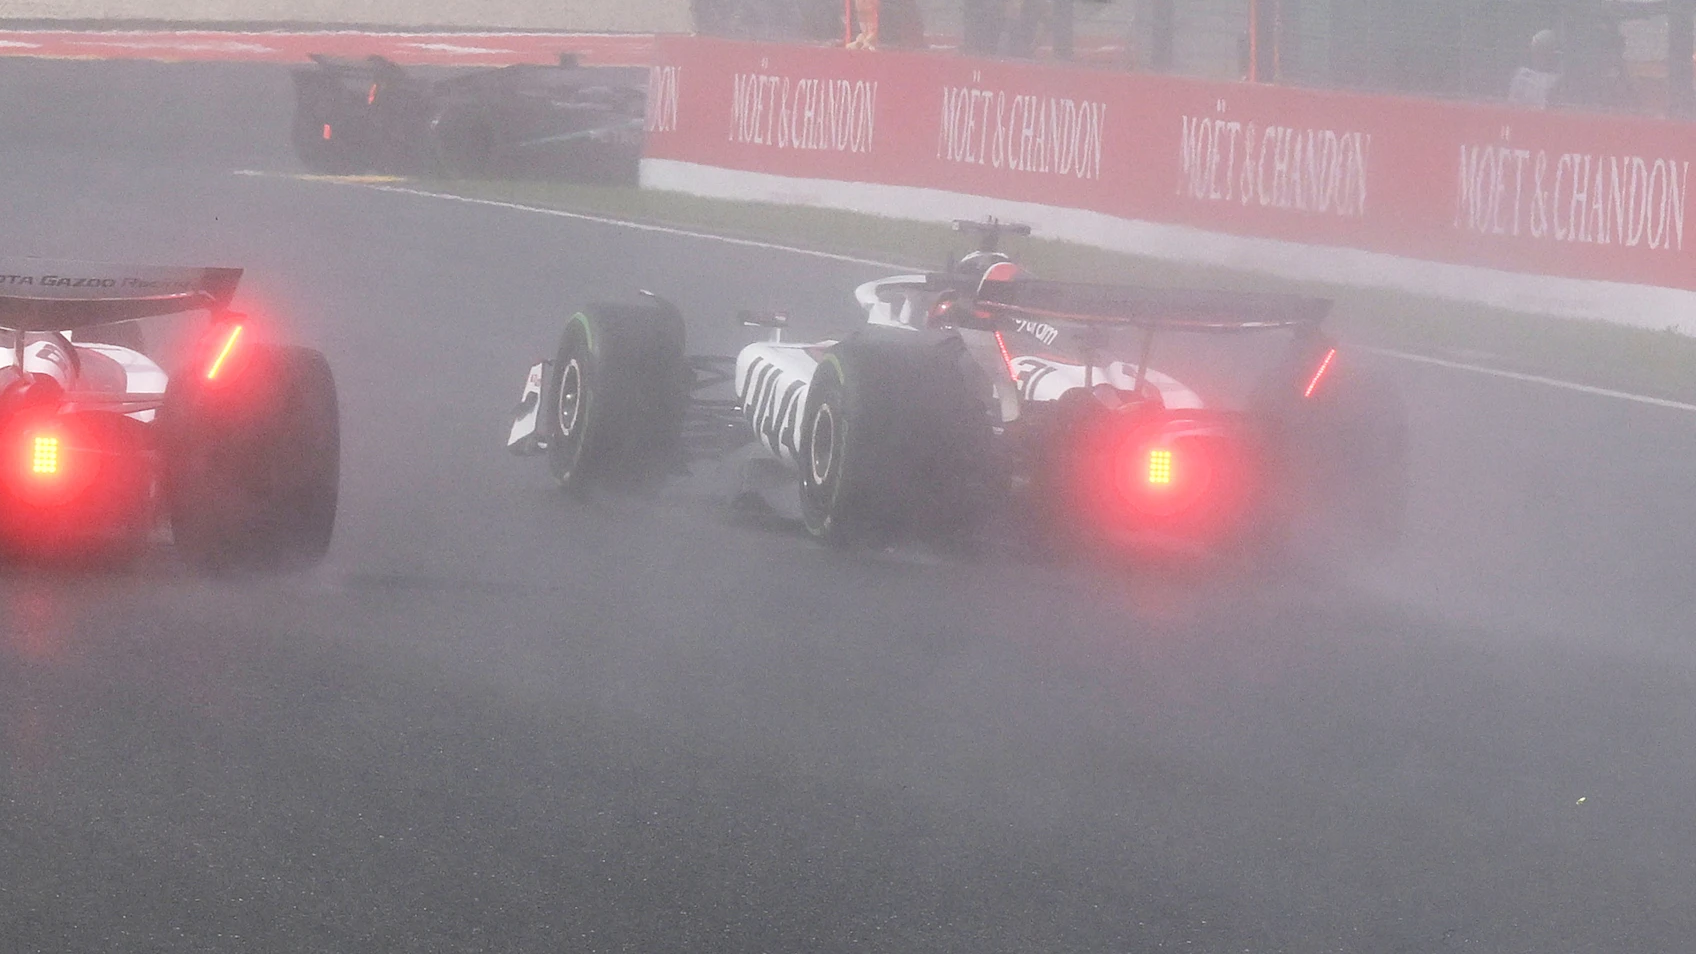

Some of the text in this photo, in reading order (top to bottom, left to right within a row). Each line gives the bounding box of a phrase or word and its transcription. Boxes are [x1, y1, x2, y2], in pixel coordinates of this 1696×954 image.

[729, 58, 878, 153] MOËT & CHANDON
[937, 70, 1107, 180] MOËT & CHANDON
[1176, 99, 1372, 216] MOËT & CHANDON
[1454, 125, 1690, 251] MOËT & CHANDON
[40, 275, 116, 288] GAZOO
